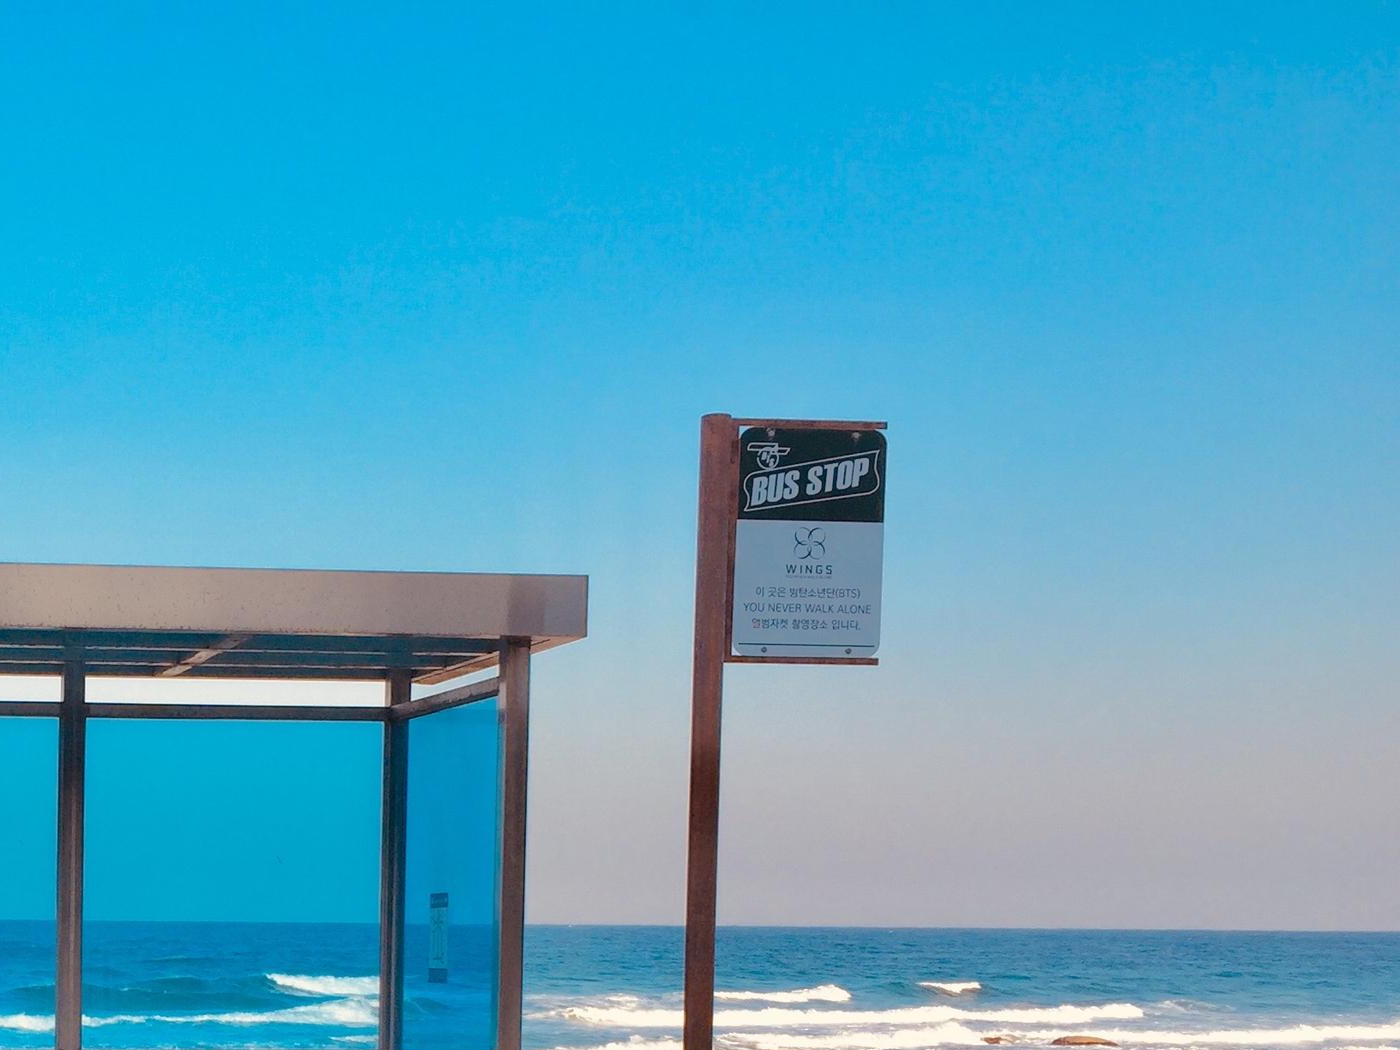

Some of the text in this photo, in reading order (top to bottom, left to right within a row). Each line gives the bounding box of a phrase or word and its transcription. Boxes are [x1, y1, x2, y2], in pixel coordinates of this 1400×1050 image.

[750, 469, 800, 507] BUS
[805, 457, 870, 496] STOP
[785, 564, 833, 575] WINGS
[755, 586, 765, 598] 이
[743, 602, 872, 615] YOU NEVER WALK ALONE
